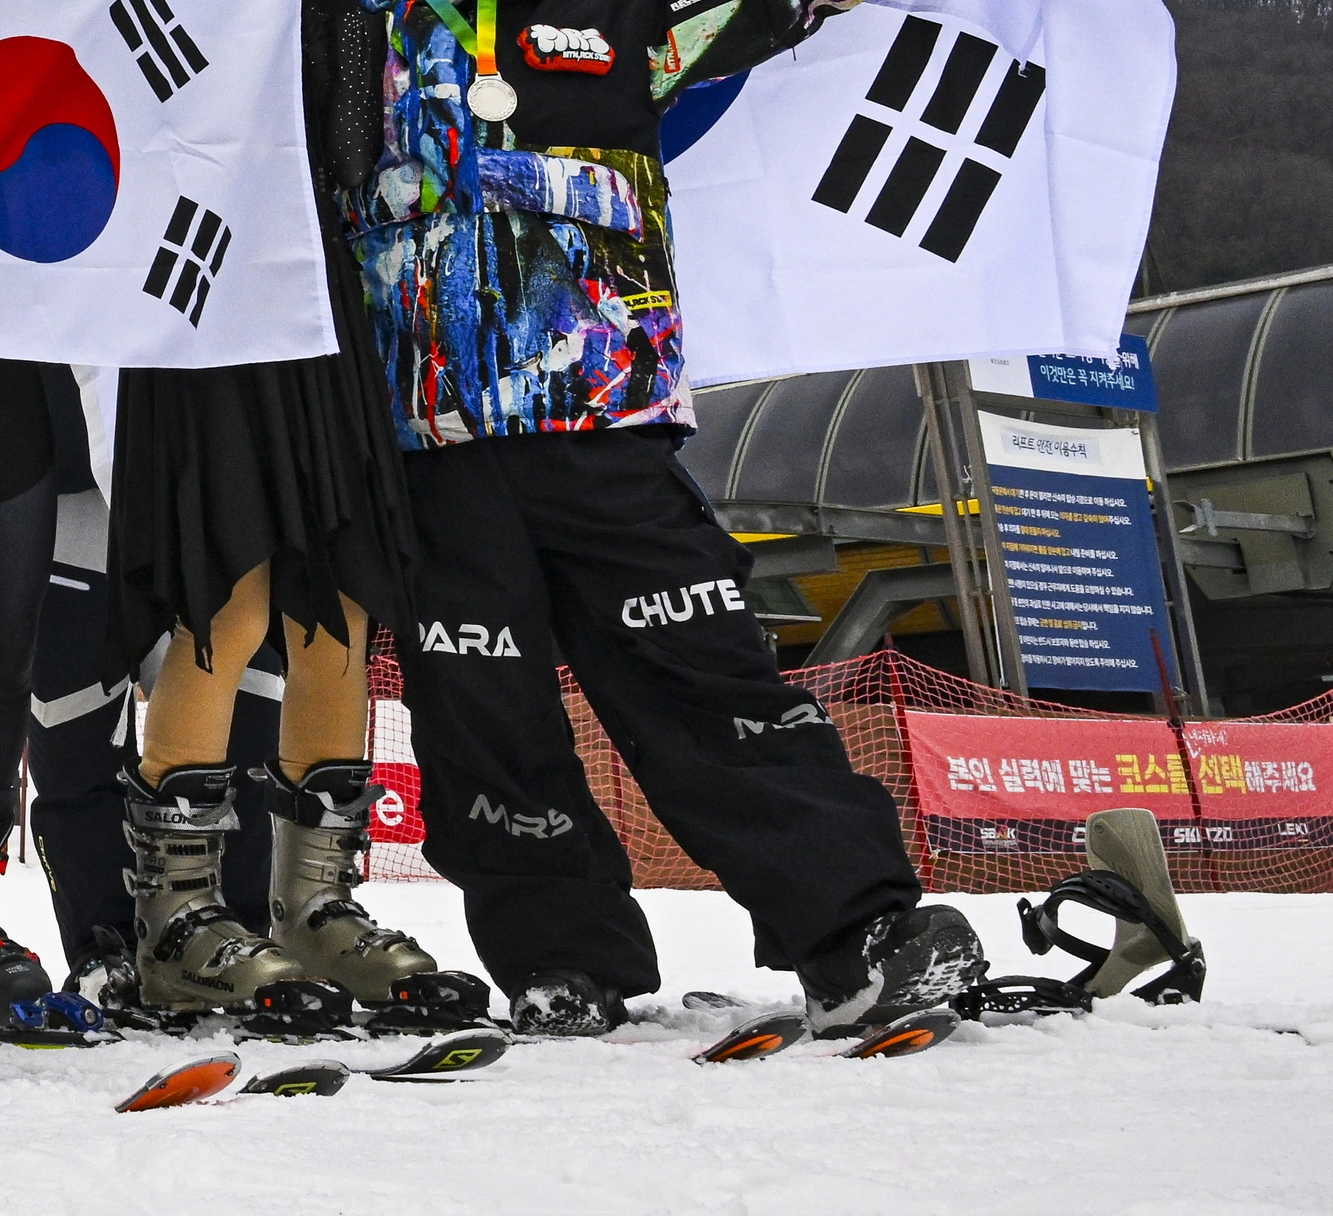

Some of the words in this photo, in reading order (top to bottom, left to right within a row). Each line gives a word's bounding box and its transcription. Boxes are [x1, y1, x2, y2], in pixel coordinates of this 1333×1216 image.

[1039, 364, 1077, 385] 이것만은
[1078, 368, 1088, 387] 꼭
[1012, 435, 1035, 450] 리프트
[1036, 439, 1053, 455] 안전
[1054, 442, 1088, 459] 이용수칙
[621, 578, 745, 628] CHUTE
[947, 756, 997, 792] 본인
[999, 758, 1066, 793] 실력에
[1068, 759, 1113, 793] 맞는
[1116, 754, 1190, 794] 코스를
